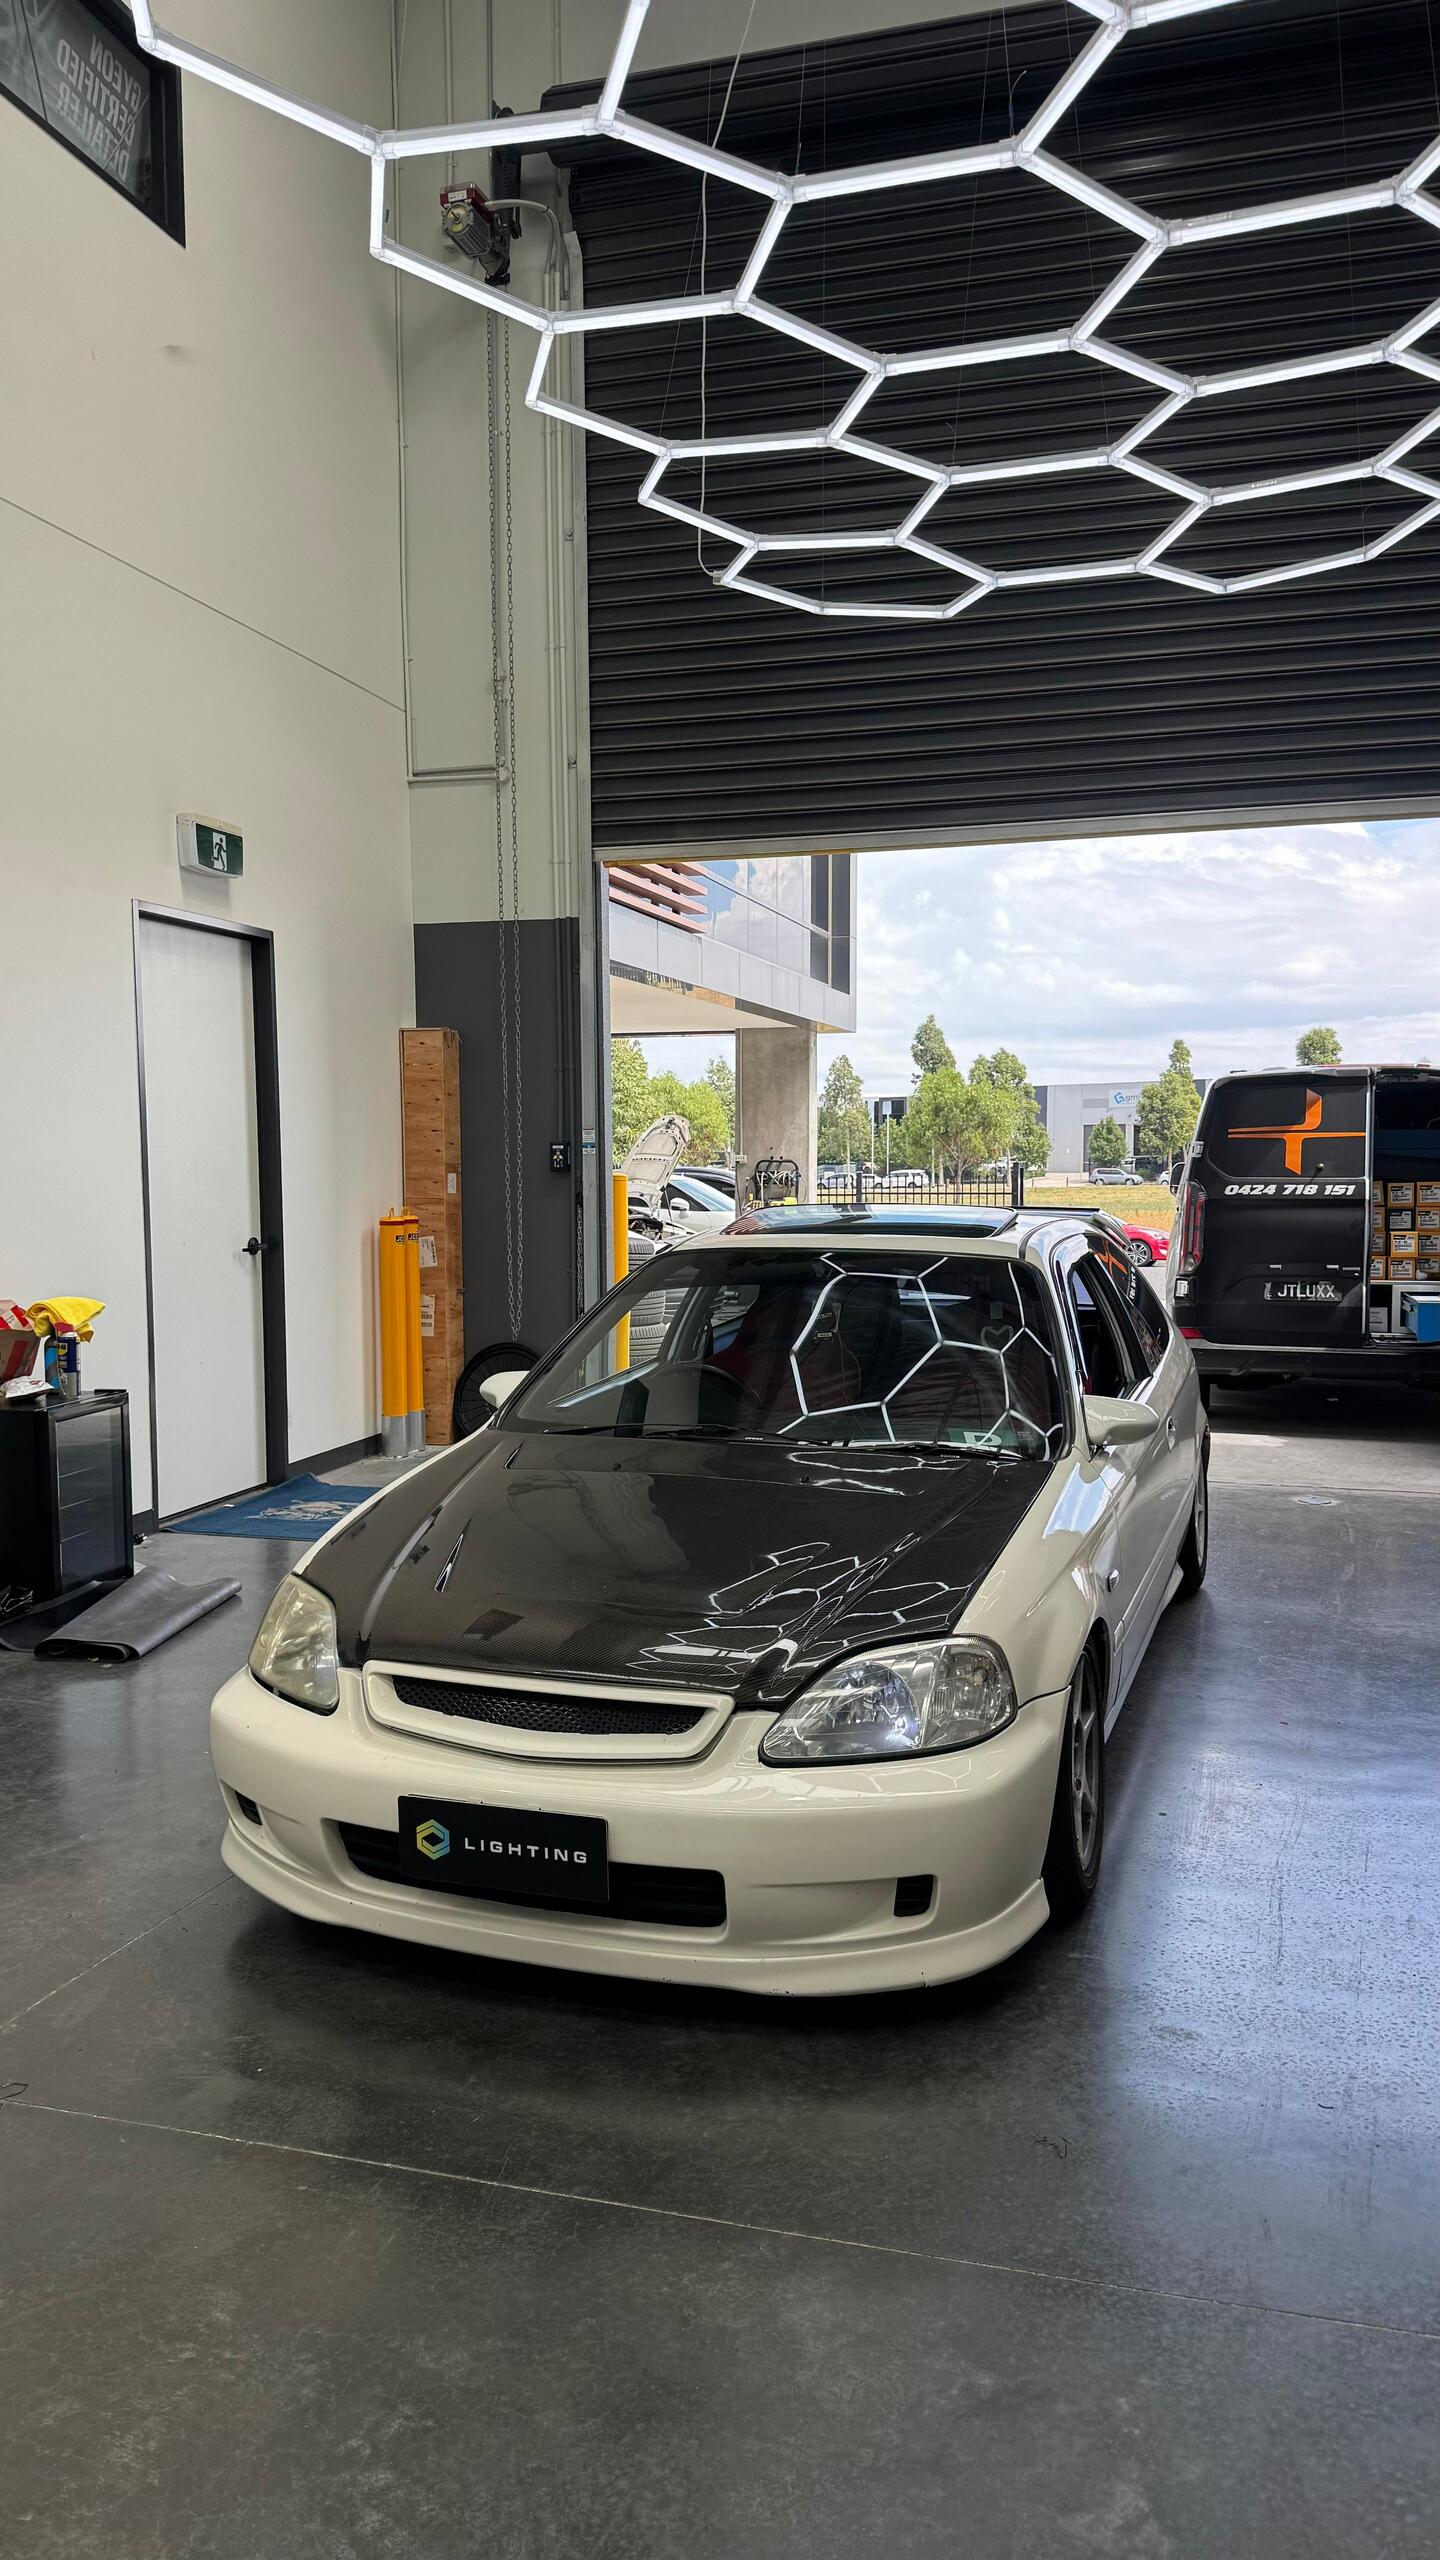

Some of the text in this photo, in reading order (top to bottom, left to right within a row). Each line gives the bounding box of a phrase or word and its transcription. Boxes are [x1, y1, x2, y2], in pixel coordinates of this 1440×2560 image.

[1224, 1184, 1356, 1196] 0424 718 151
[1277, 1284, 1335, 1298] JTLUXX
[464, 1837, 588, 1864] LIGHTING
